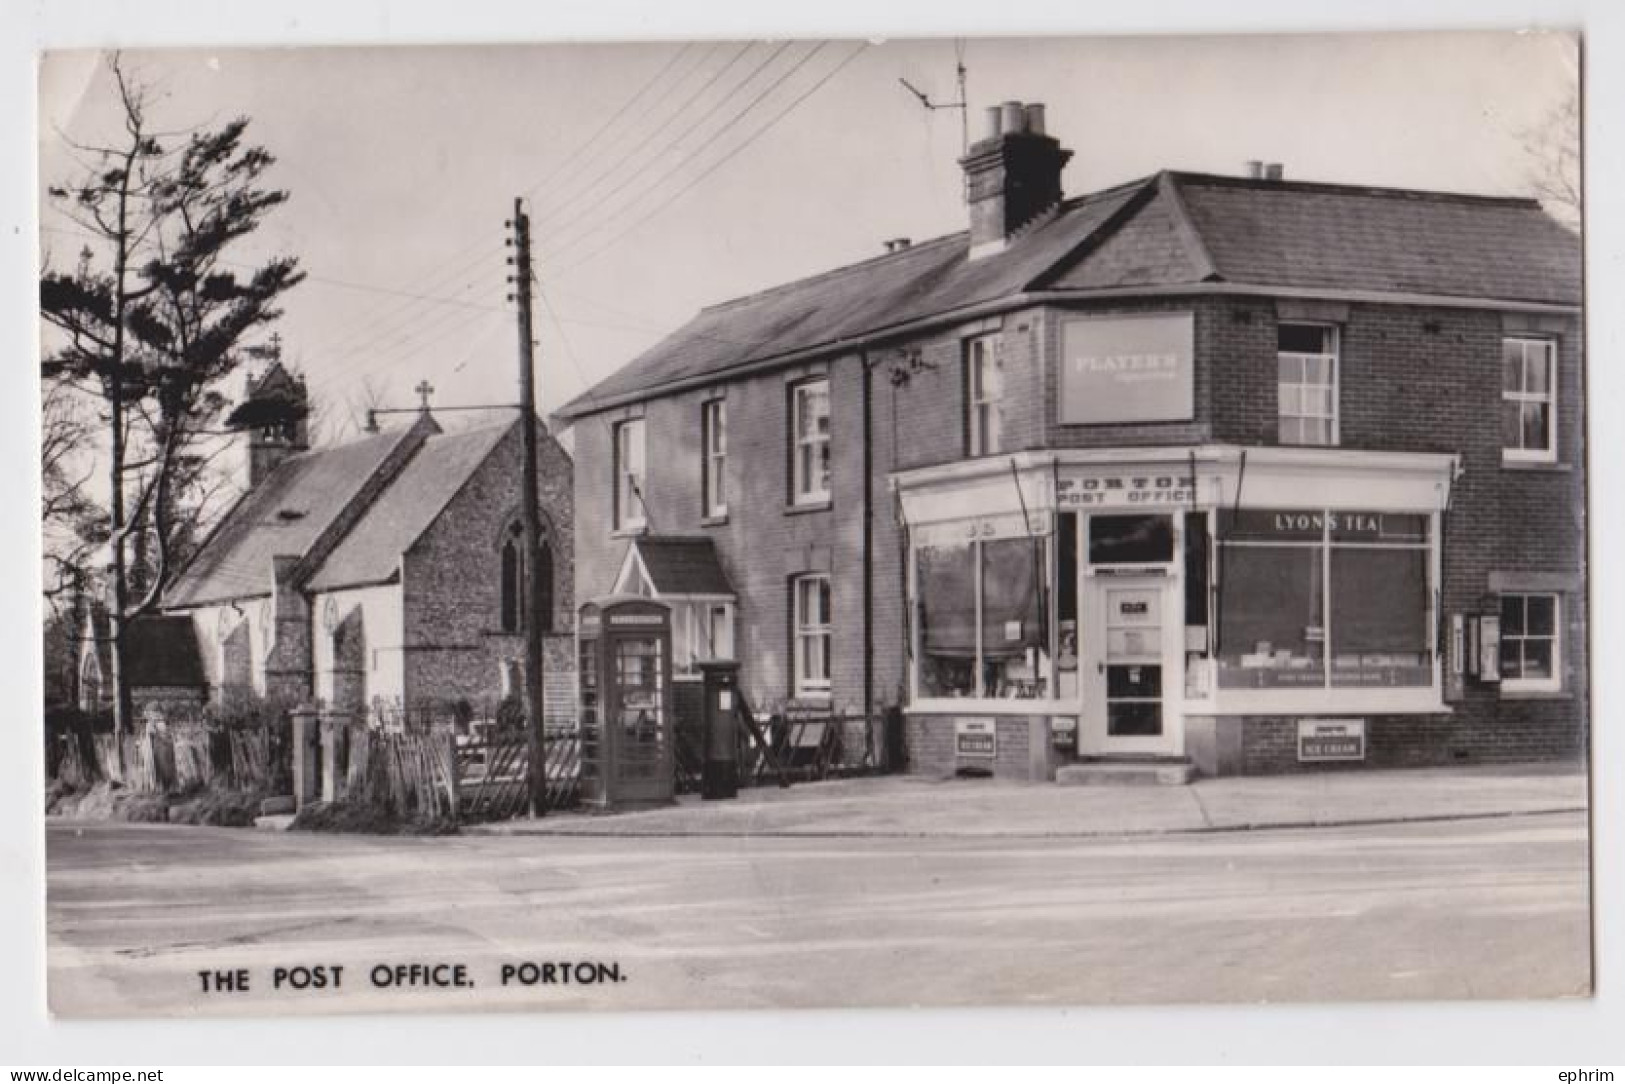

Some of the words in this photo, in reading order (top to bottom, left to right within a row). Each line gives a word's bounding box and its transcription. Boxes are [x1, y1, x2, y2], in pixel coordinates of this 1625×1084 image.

[1056, 476, 1195, 491] PORTON
[1056, 492, 1104, 503] POST
[1127, 490, 1195, 502] OFFICE
[1343, 513, 1378, 531] TEA
